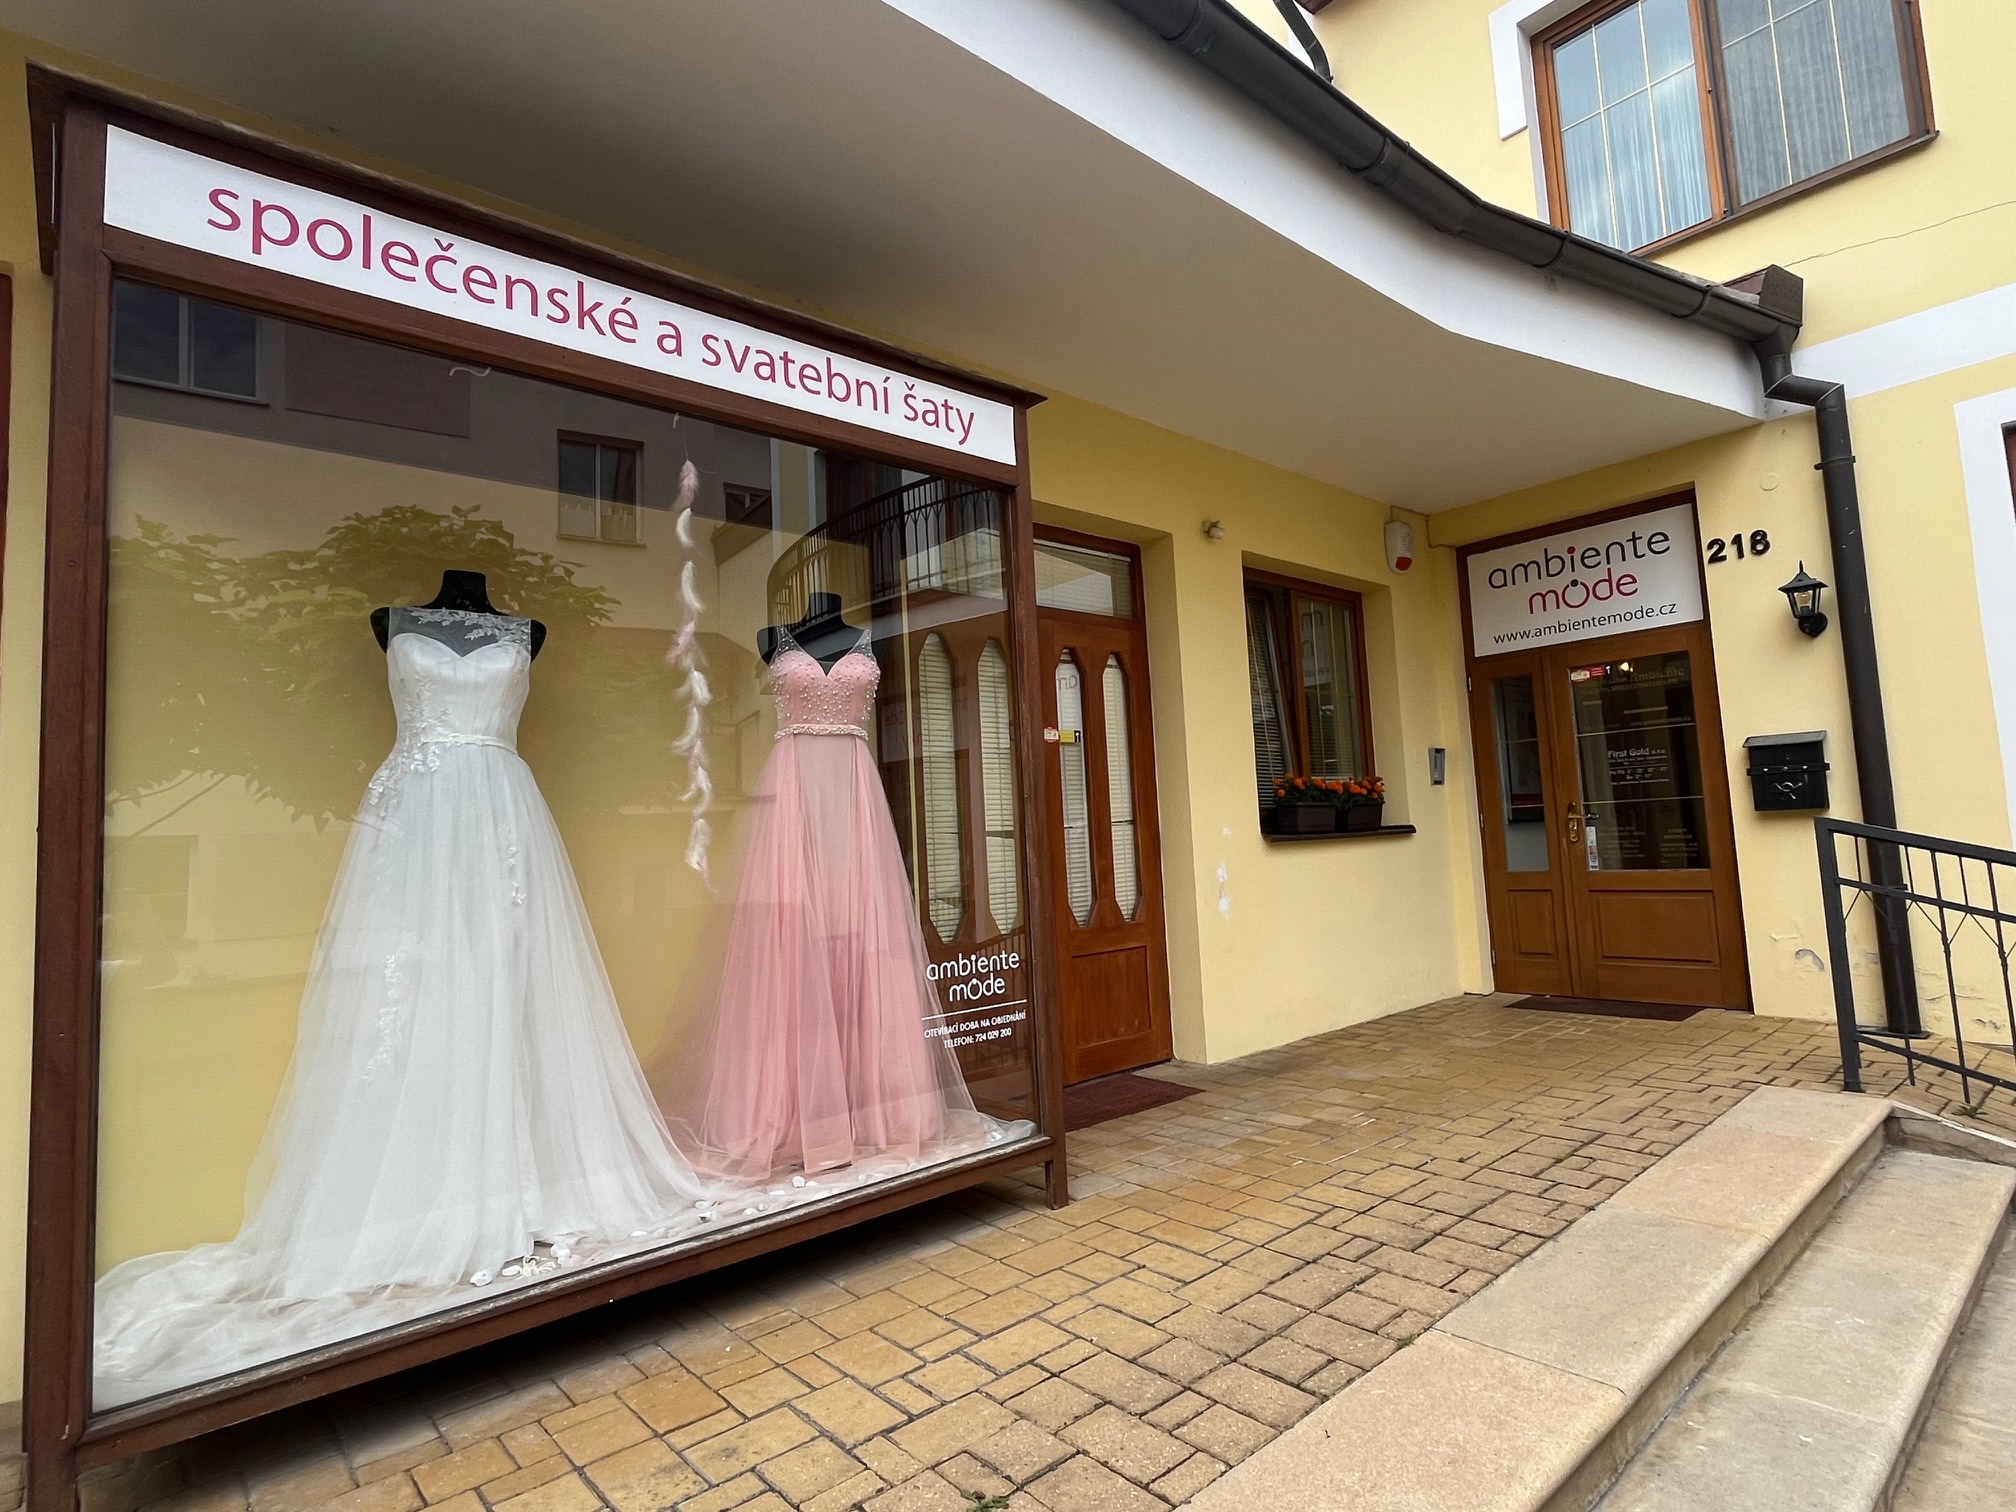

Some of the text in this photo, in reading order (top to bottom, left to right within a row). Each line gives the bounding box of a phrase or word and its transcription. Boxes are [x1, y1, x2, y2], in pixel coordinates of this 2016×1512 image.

[206, 187, 975, 446] společenské a svatební šaty
[1488, 529, 1671, 590] ambiente
[1706, 529, 1771, 564] 218
[1493, 601, 1678, 644] www.ambientemode.cz
[1607, 749, 1628, 758] First
[1629, 747, 1650, 756] Gold
[926, 949, 1020, 981] ambiente
[923, 1021, 959, 1039] OTEVÍRACÍ
[959, 1020, 980, 1032] DOBA
[980, 1018, 991, 1028] NA
[943, 1027, 1012, 1049] TELEFON: 724 029 200
